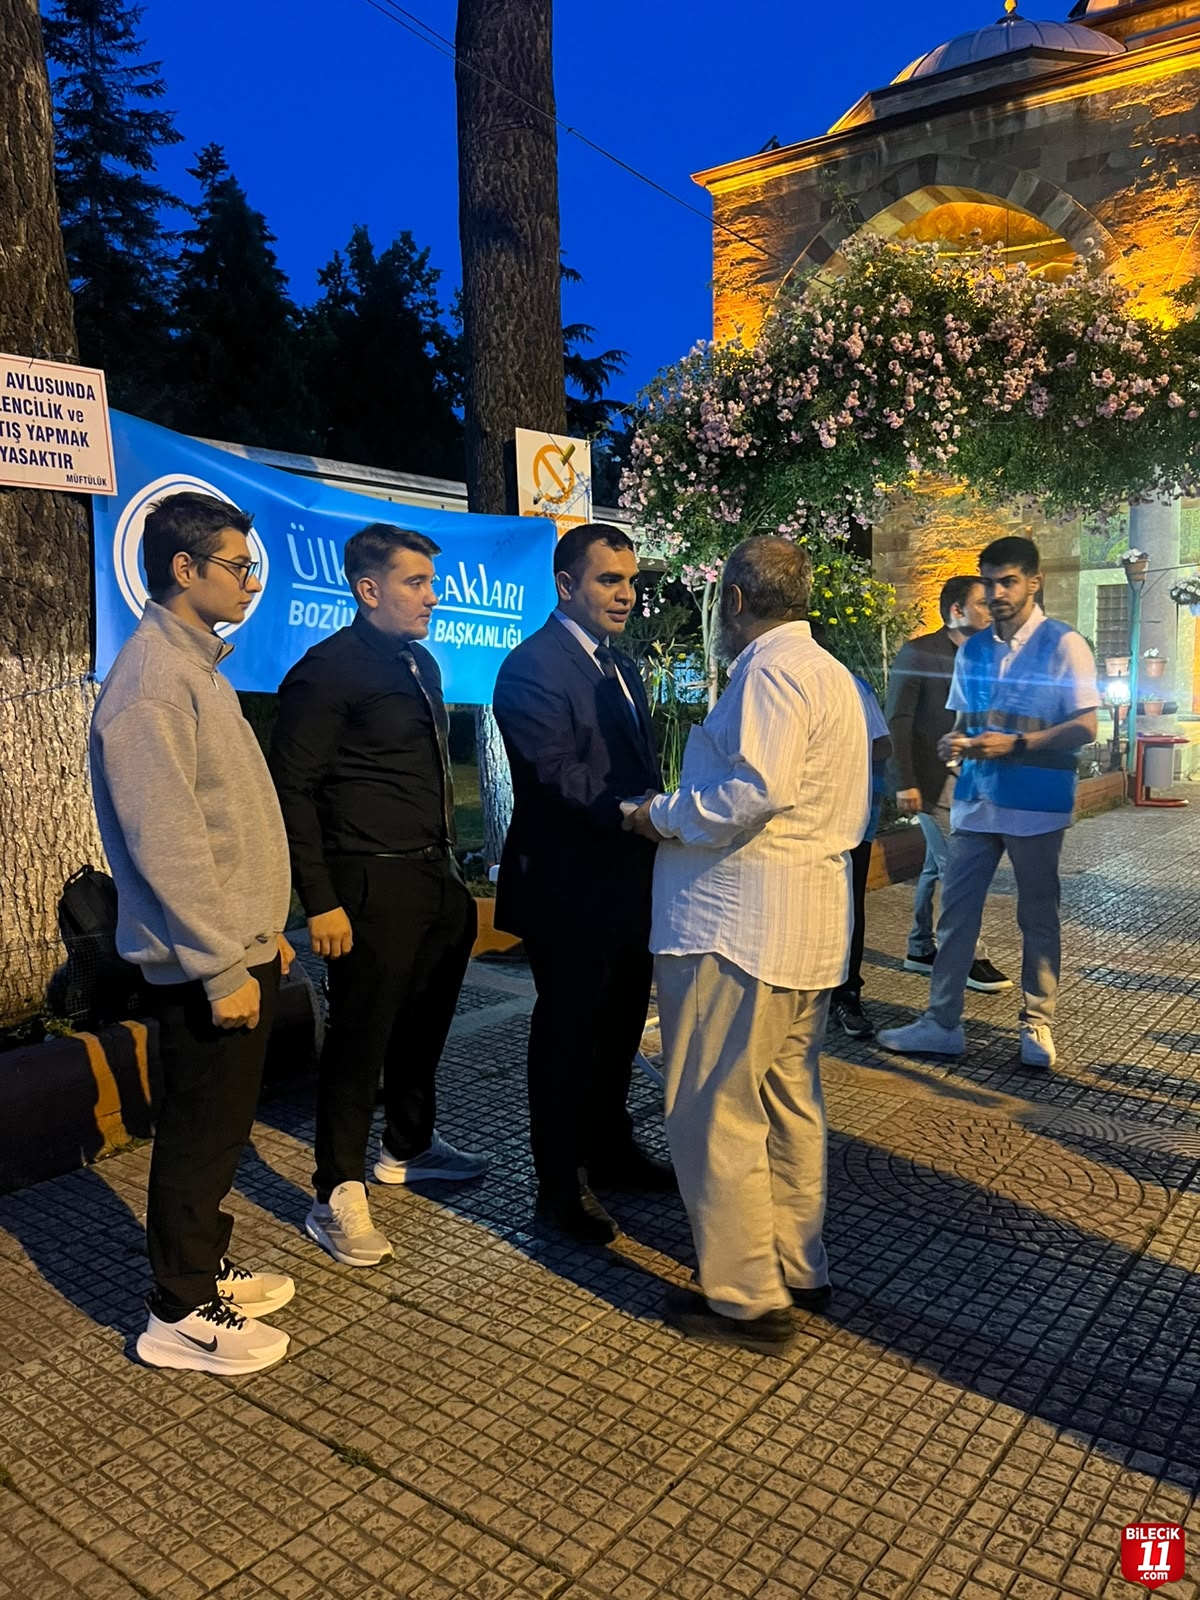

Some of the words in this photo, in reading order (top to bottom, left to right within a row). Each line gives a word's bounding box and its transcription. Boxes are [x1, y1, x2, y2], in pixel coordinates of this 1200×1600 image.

[6, 371, 96, 401] AVLUSUNDA
[67, 408, 85, 423] ve
[0, 420, 22, 444] TIŞ
[26, 423, 90, 448] YAPMAK
[0, 446, 74, 470] YASAKTIR
[66, 474, 107, 486] MÜFTÜLÜK
[288, 599, 357, 630] BOZÜ
[434, 619, 522, 649] BAŞKANLIĞI
